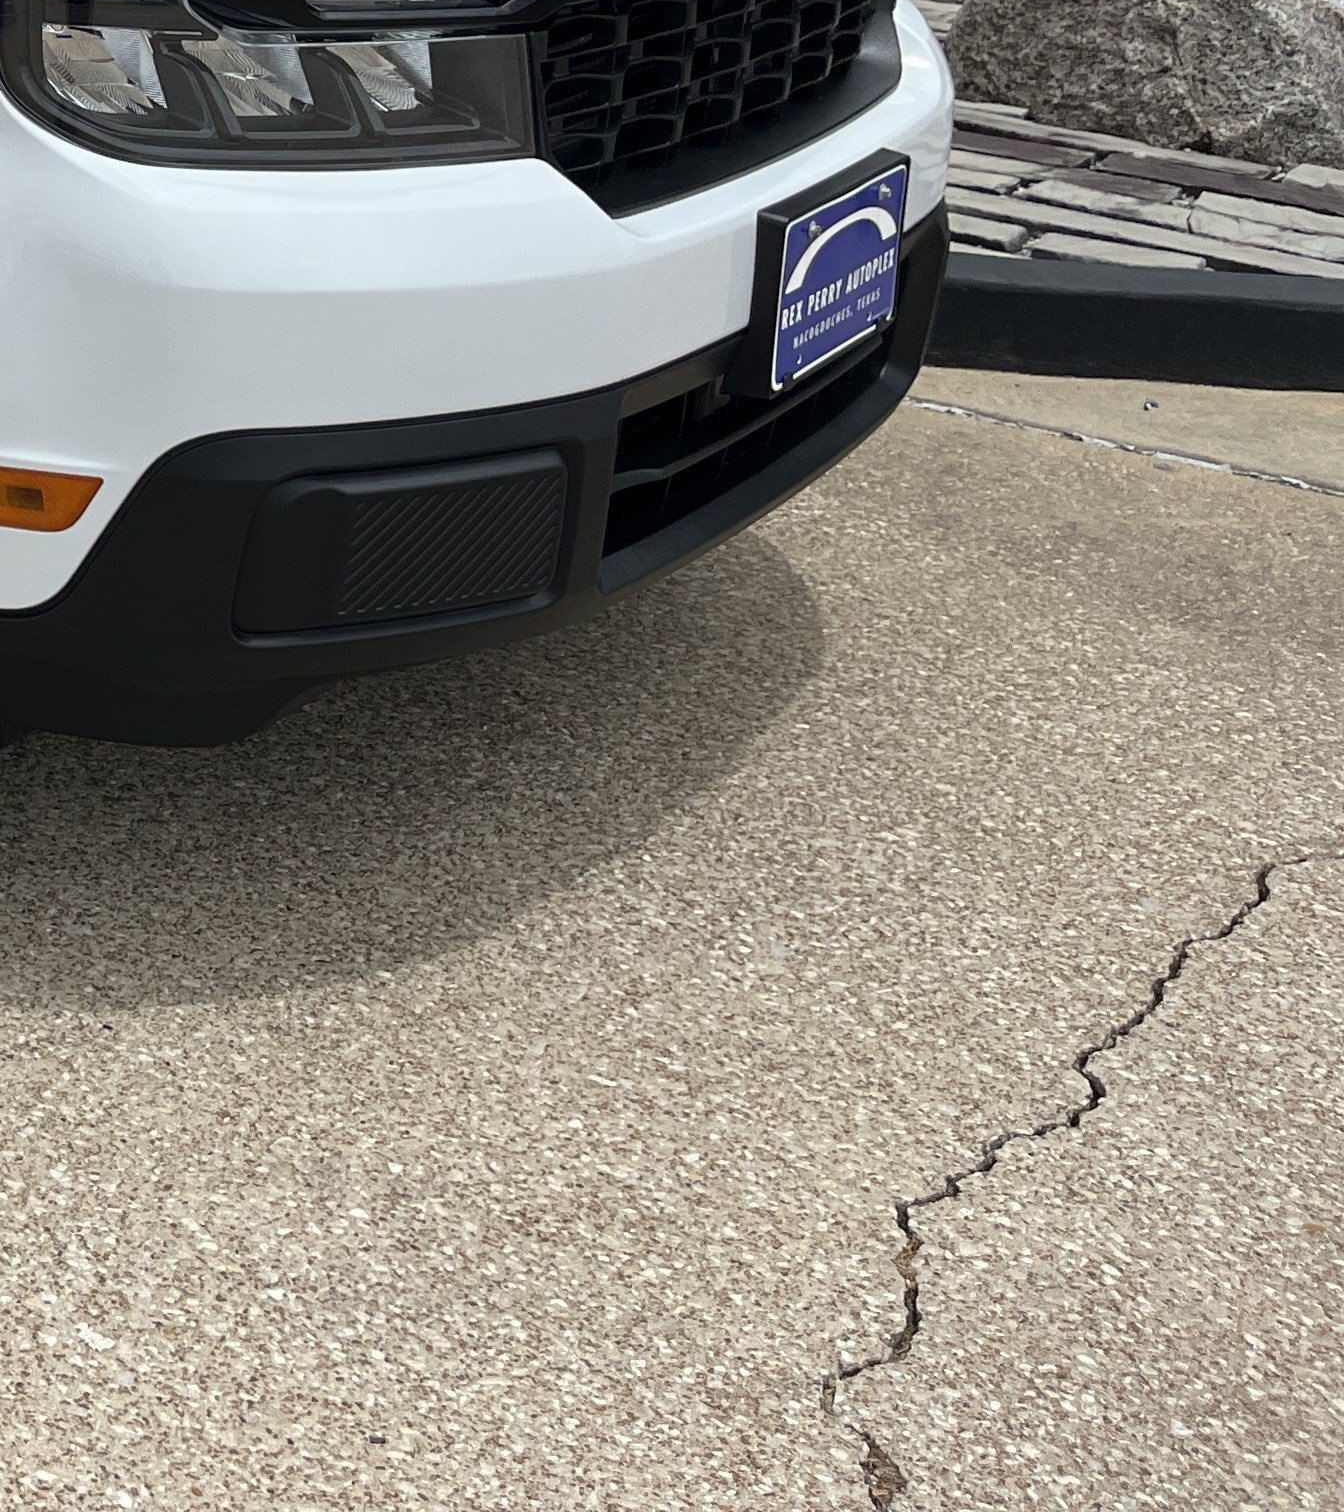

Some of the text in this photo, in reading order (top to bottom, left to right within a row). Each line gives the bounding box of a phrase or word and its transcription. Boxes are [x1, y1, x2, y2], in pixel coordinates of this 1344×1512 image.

[781, 247, 895, 331] REX PERRY AUTOPLEX
[856, 287, 881, 311] TEXAS
